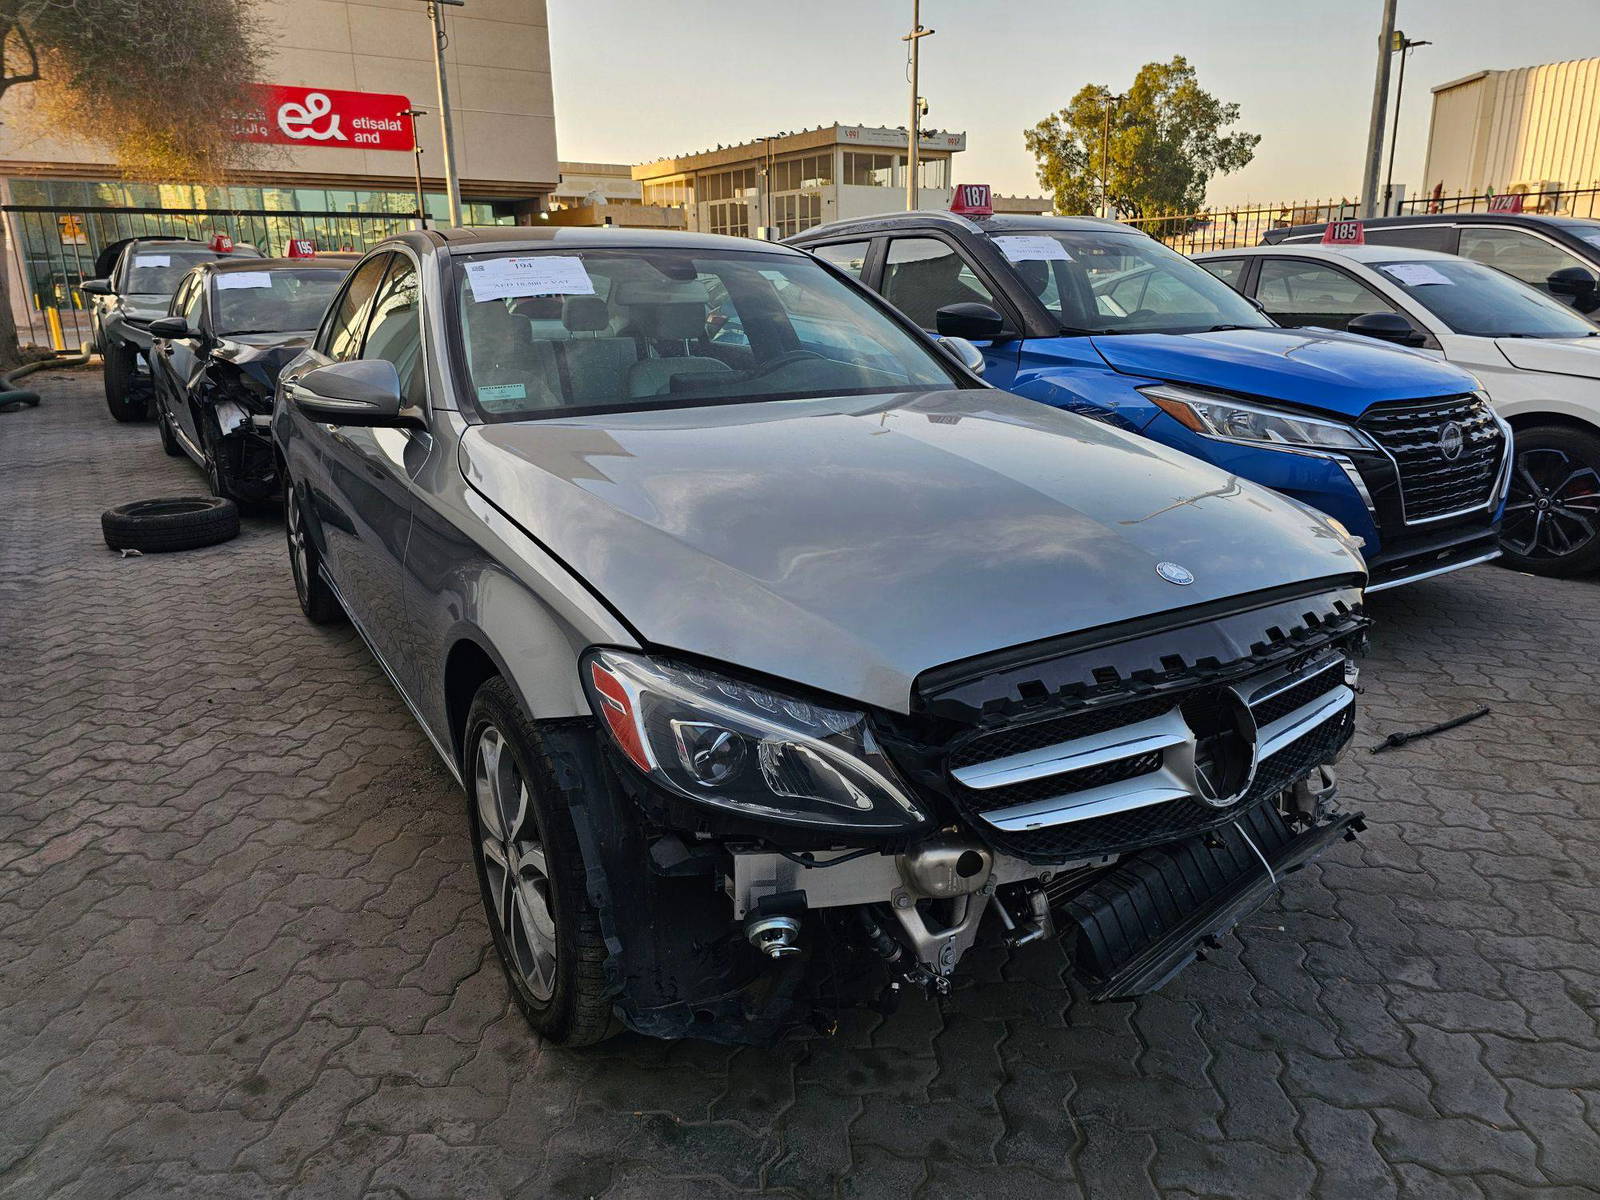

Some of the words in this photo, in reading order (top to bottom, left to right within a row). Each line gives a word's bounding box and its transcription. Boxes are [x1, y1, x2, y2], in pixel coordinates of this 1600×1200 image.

[352, 118, 403, 132] etisalat
[354, 131, 381, 144] and
[965, 186, 987, 207] 187
[1494, 195, 1514, 210] 174
[1333, 223, 1357, 240] 185
[297, 240, 313, 255] 195
[514, 262, 533, 270] 194
